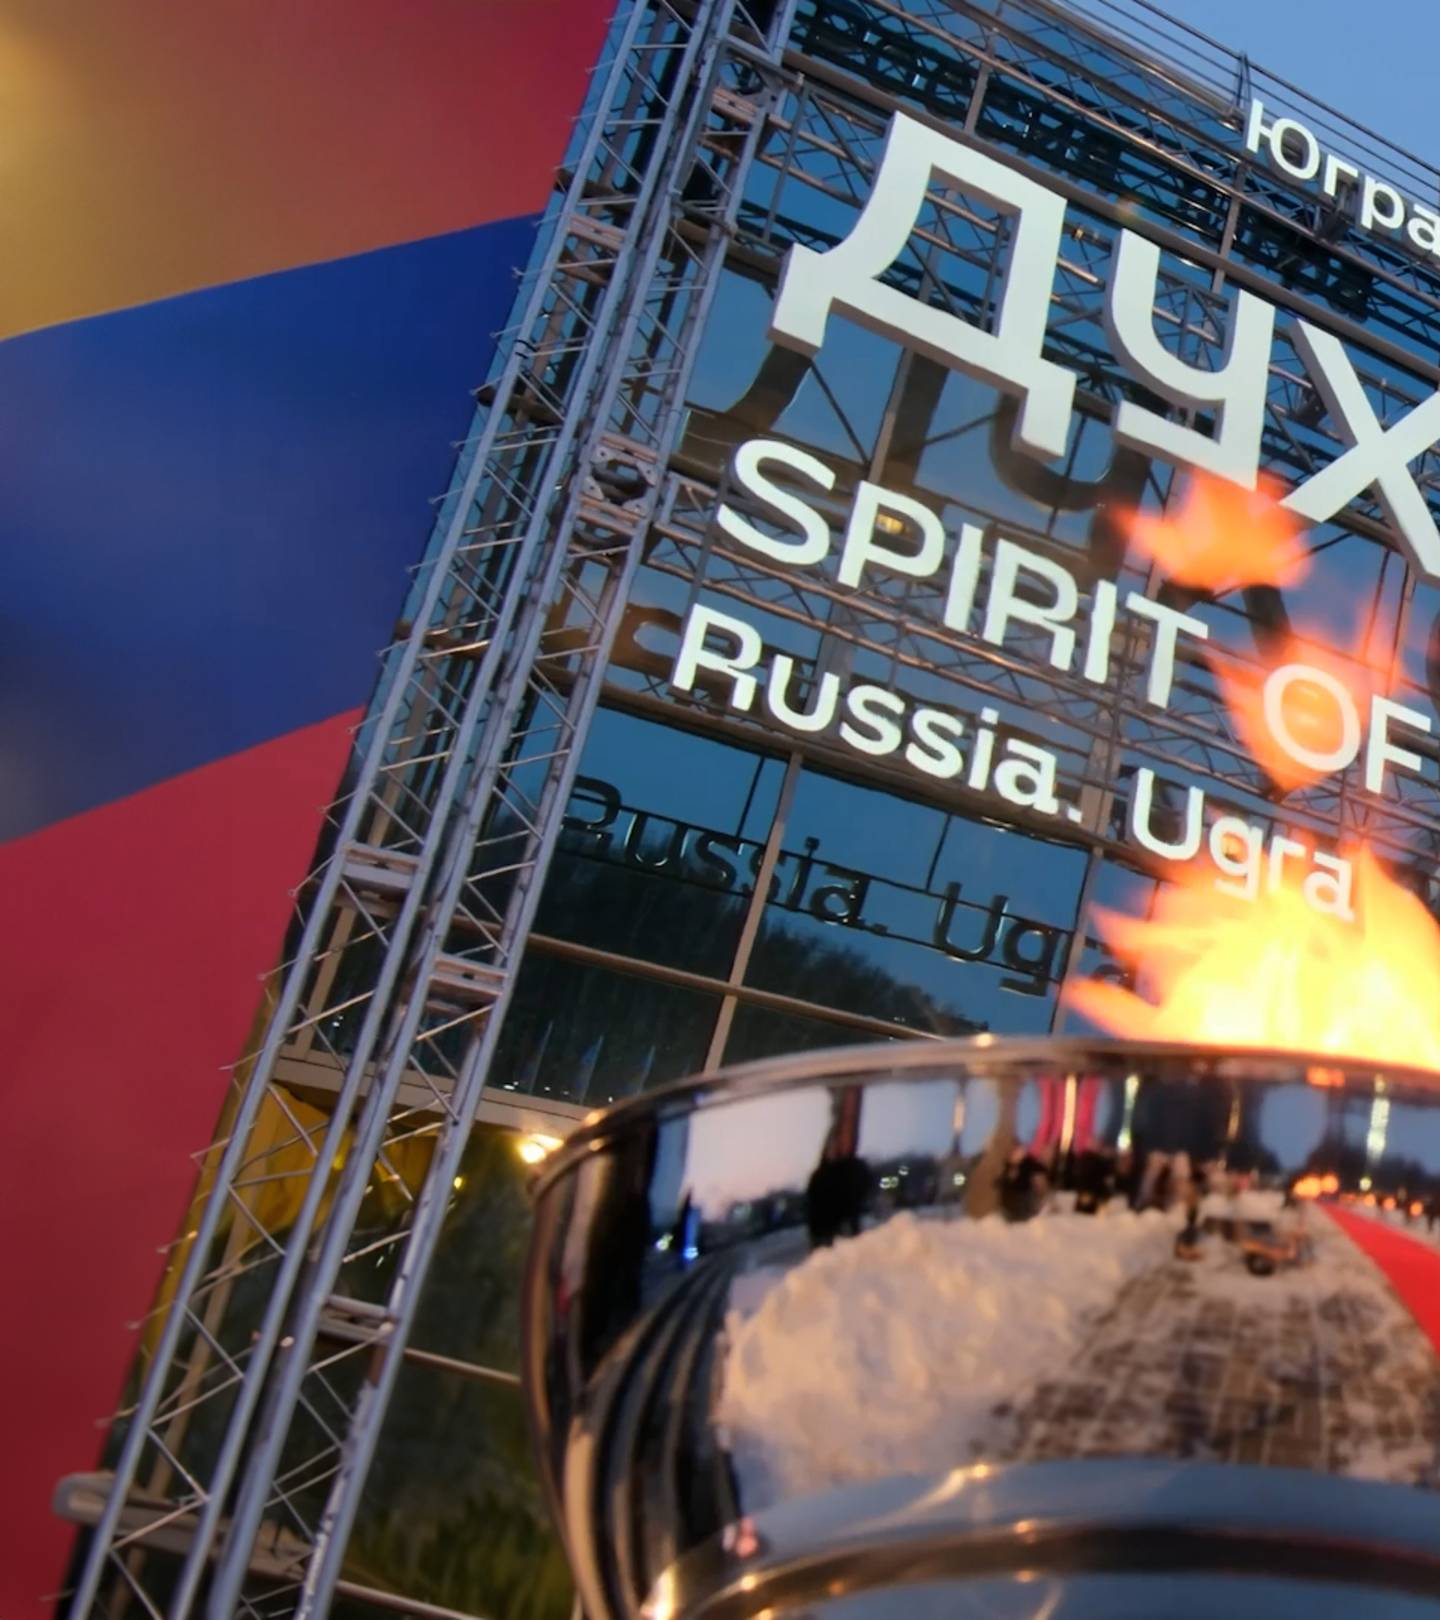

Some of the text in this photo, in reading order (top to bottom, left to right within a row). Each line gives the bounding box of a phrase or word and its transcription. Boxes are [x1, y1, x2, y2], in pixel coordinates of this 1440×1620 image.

[672, 603, 1355, 922] Russia. Ugra
[717, 439, 1209, 709] SPIRIT
[1263, 663, 1431, 794] OF
